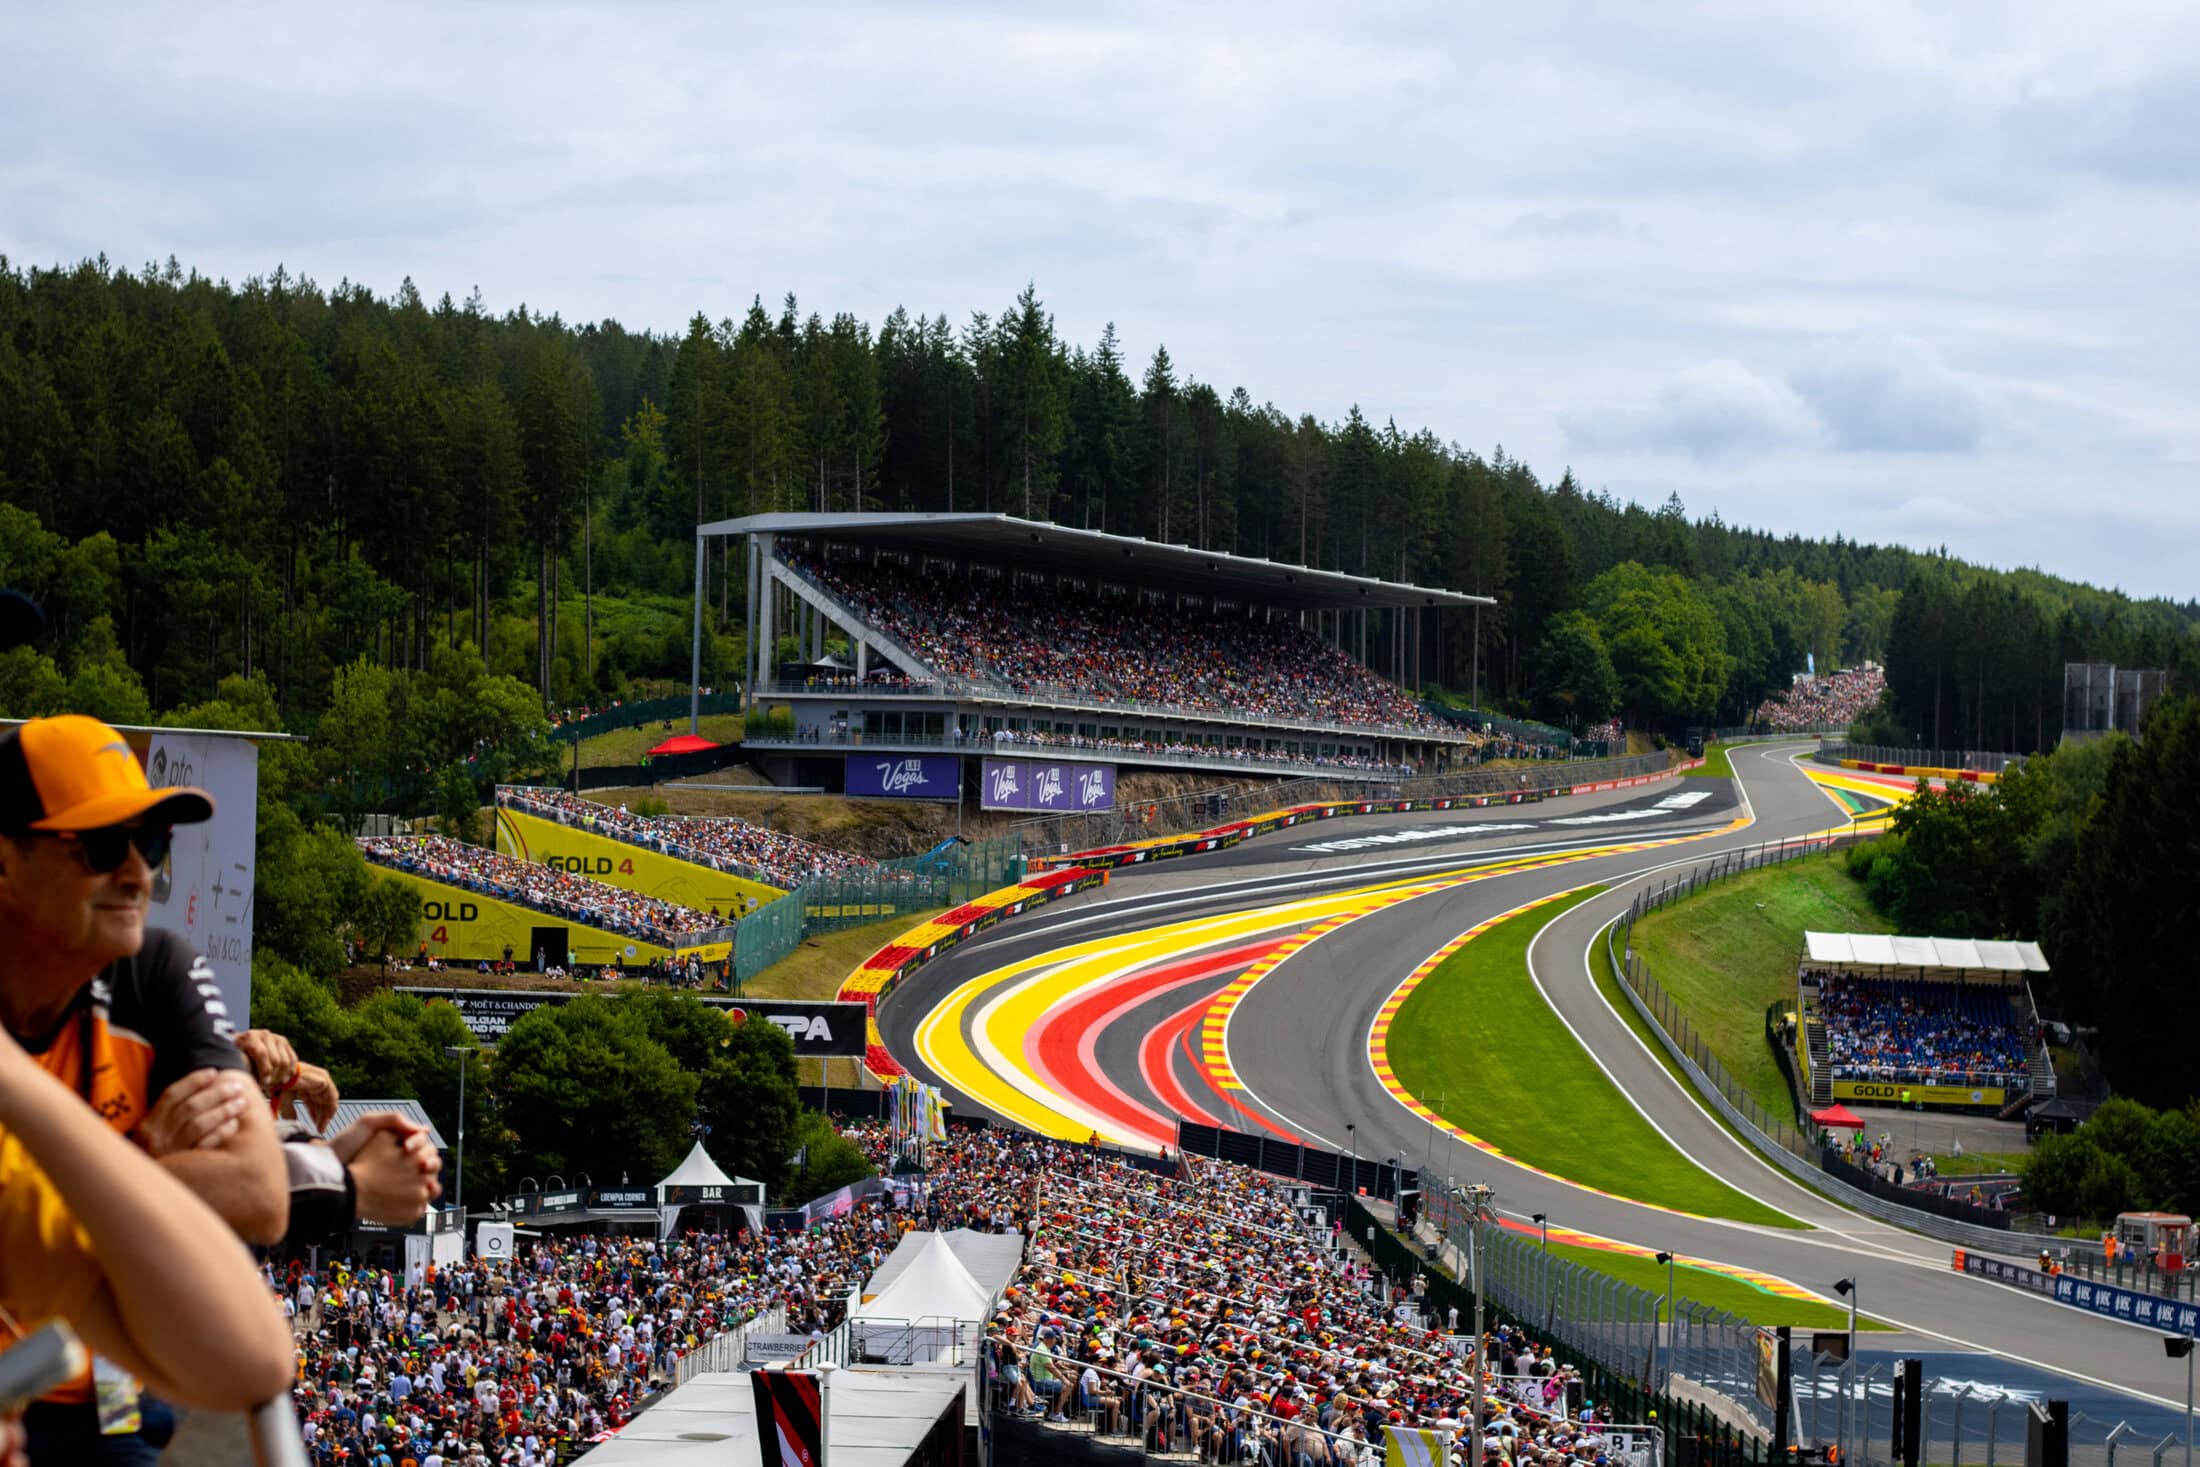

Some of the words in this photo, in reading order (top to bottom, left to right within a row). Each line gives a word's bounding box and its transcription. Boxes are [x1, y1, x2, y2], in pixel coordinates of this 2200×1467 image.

[876, 761, 928, 793] Vegas
[991, 768, 1019, 804] Vegas
[1036, 770, 1063, 806] Vegas
[1080, 772, 1106, 807] Vegas
[548, 856, 613, 875] GOLD
[619, 858, 634, 876] 4
[424, 902, 478, 922] OLD
[431, 926, 448, 944] 4
[466, 1025, 488, 1033] AND
[1854, 1085, 1894, 1097] GOLD
[625, 1192, 646, 1202] CORNER
[703, 1187, 722, 1199] BAR
[1320, 1232, 1327, 1240] H
[1465, 1344, 1475, 1355] D
[1525, 1386, 1536, 1398] C
[1612, 1435, 1625, 1450] B
